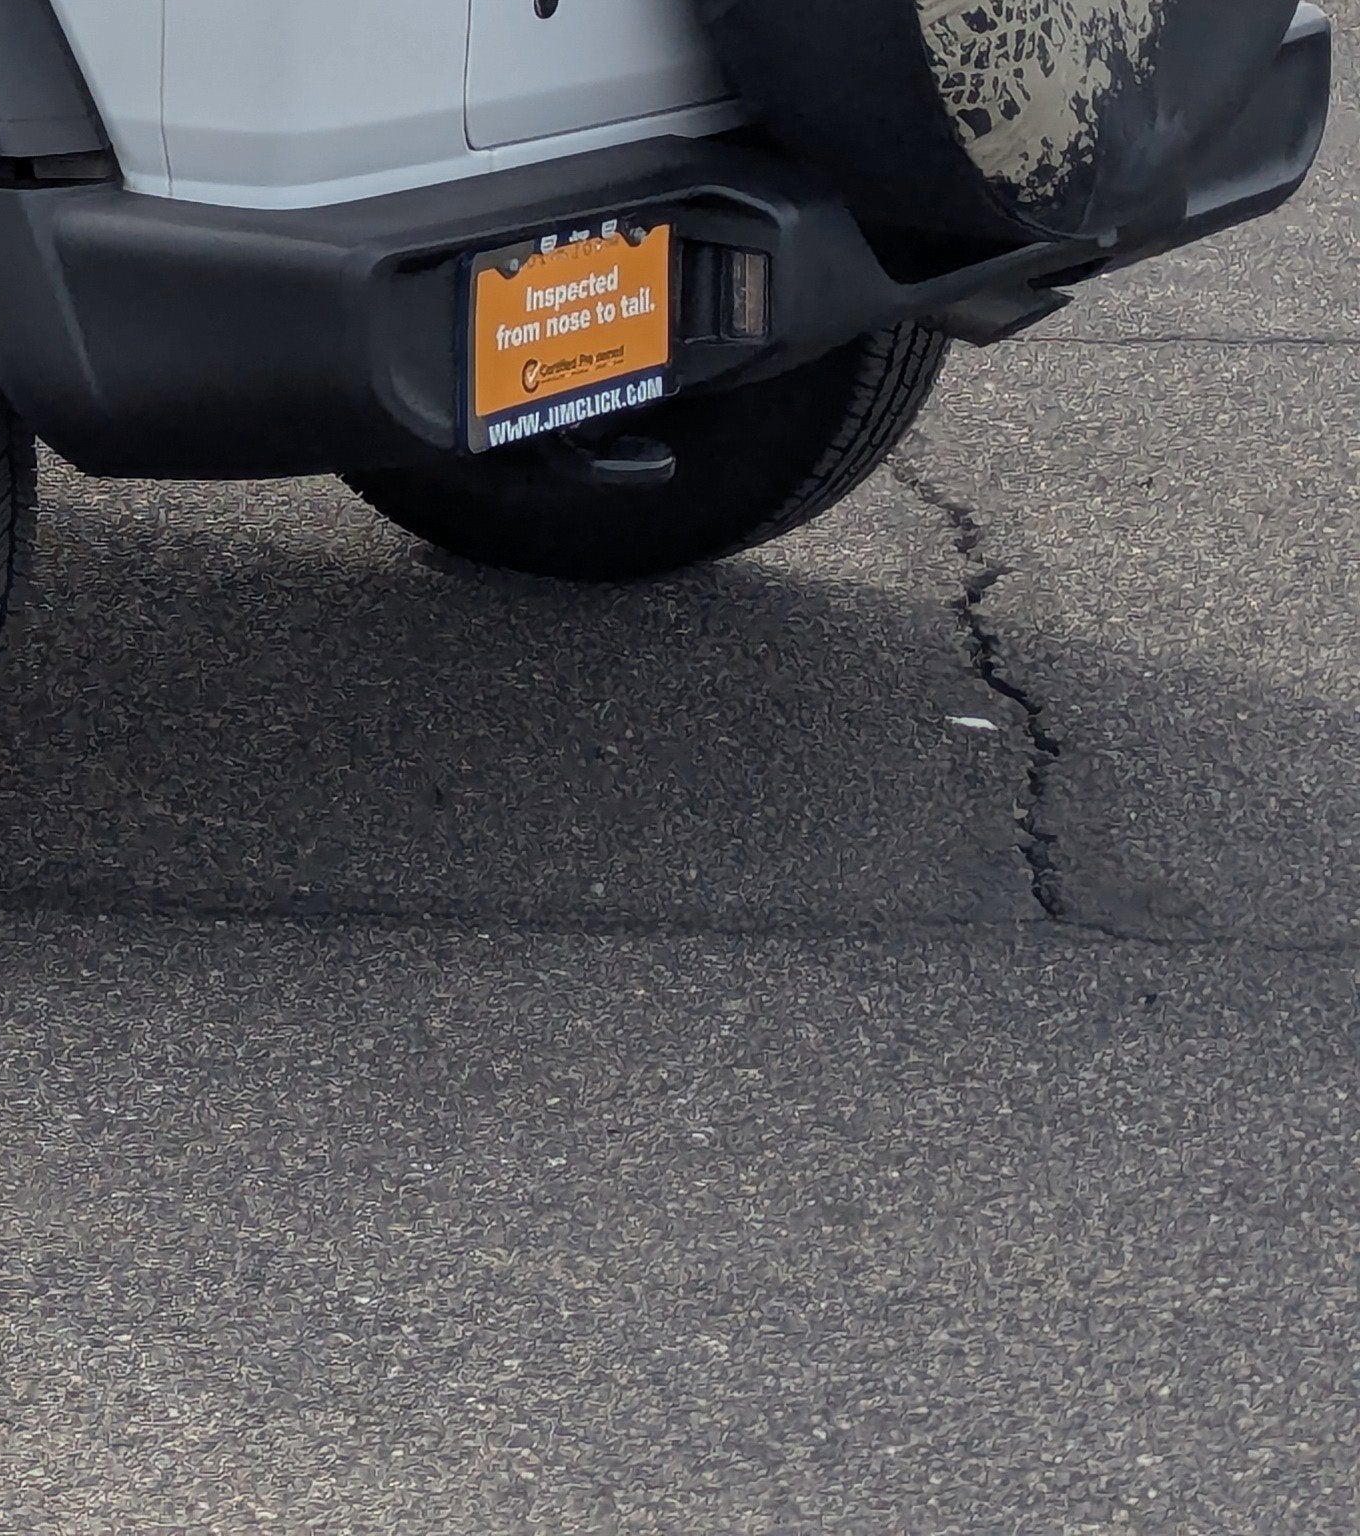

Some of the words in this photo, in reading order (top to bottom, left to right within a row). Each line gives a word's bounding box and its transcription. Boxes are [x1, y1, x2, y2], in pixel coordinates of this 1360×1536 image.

[495, 321, 541, 351] from
[546, 309, 591, 339] nose
[595, 300, 616, 324] to
[620, 286, 656, 317] tail.
[526, 265, 619, 312] Inspected
[487, 376, 664, 447] WWW.JIMCLICK.COM
